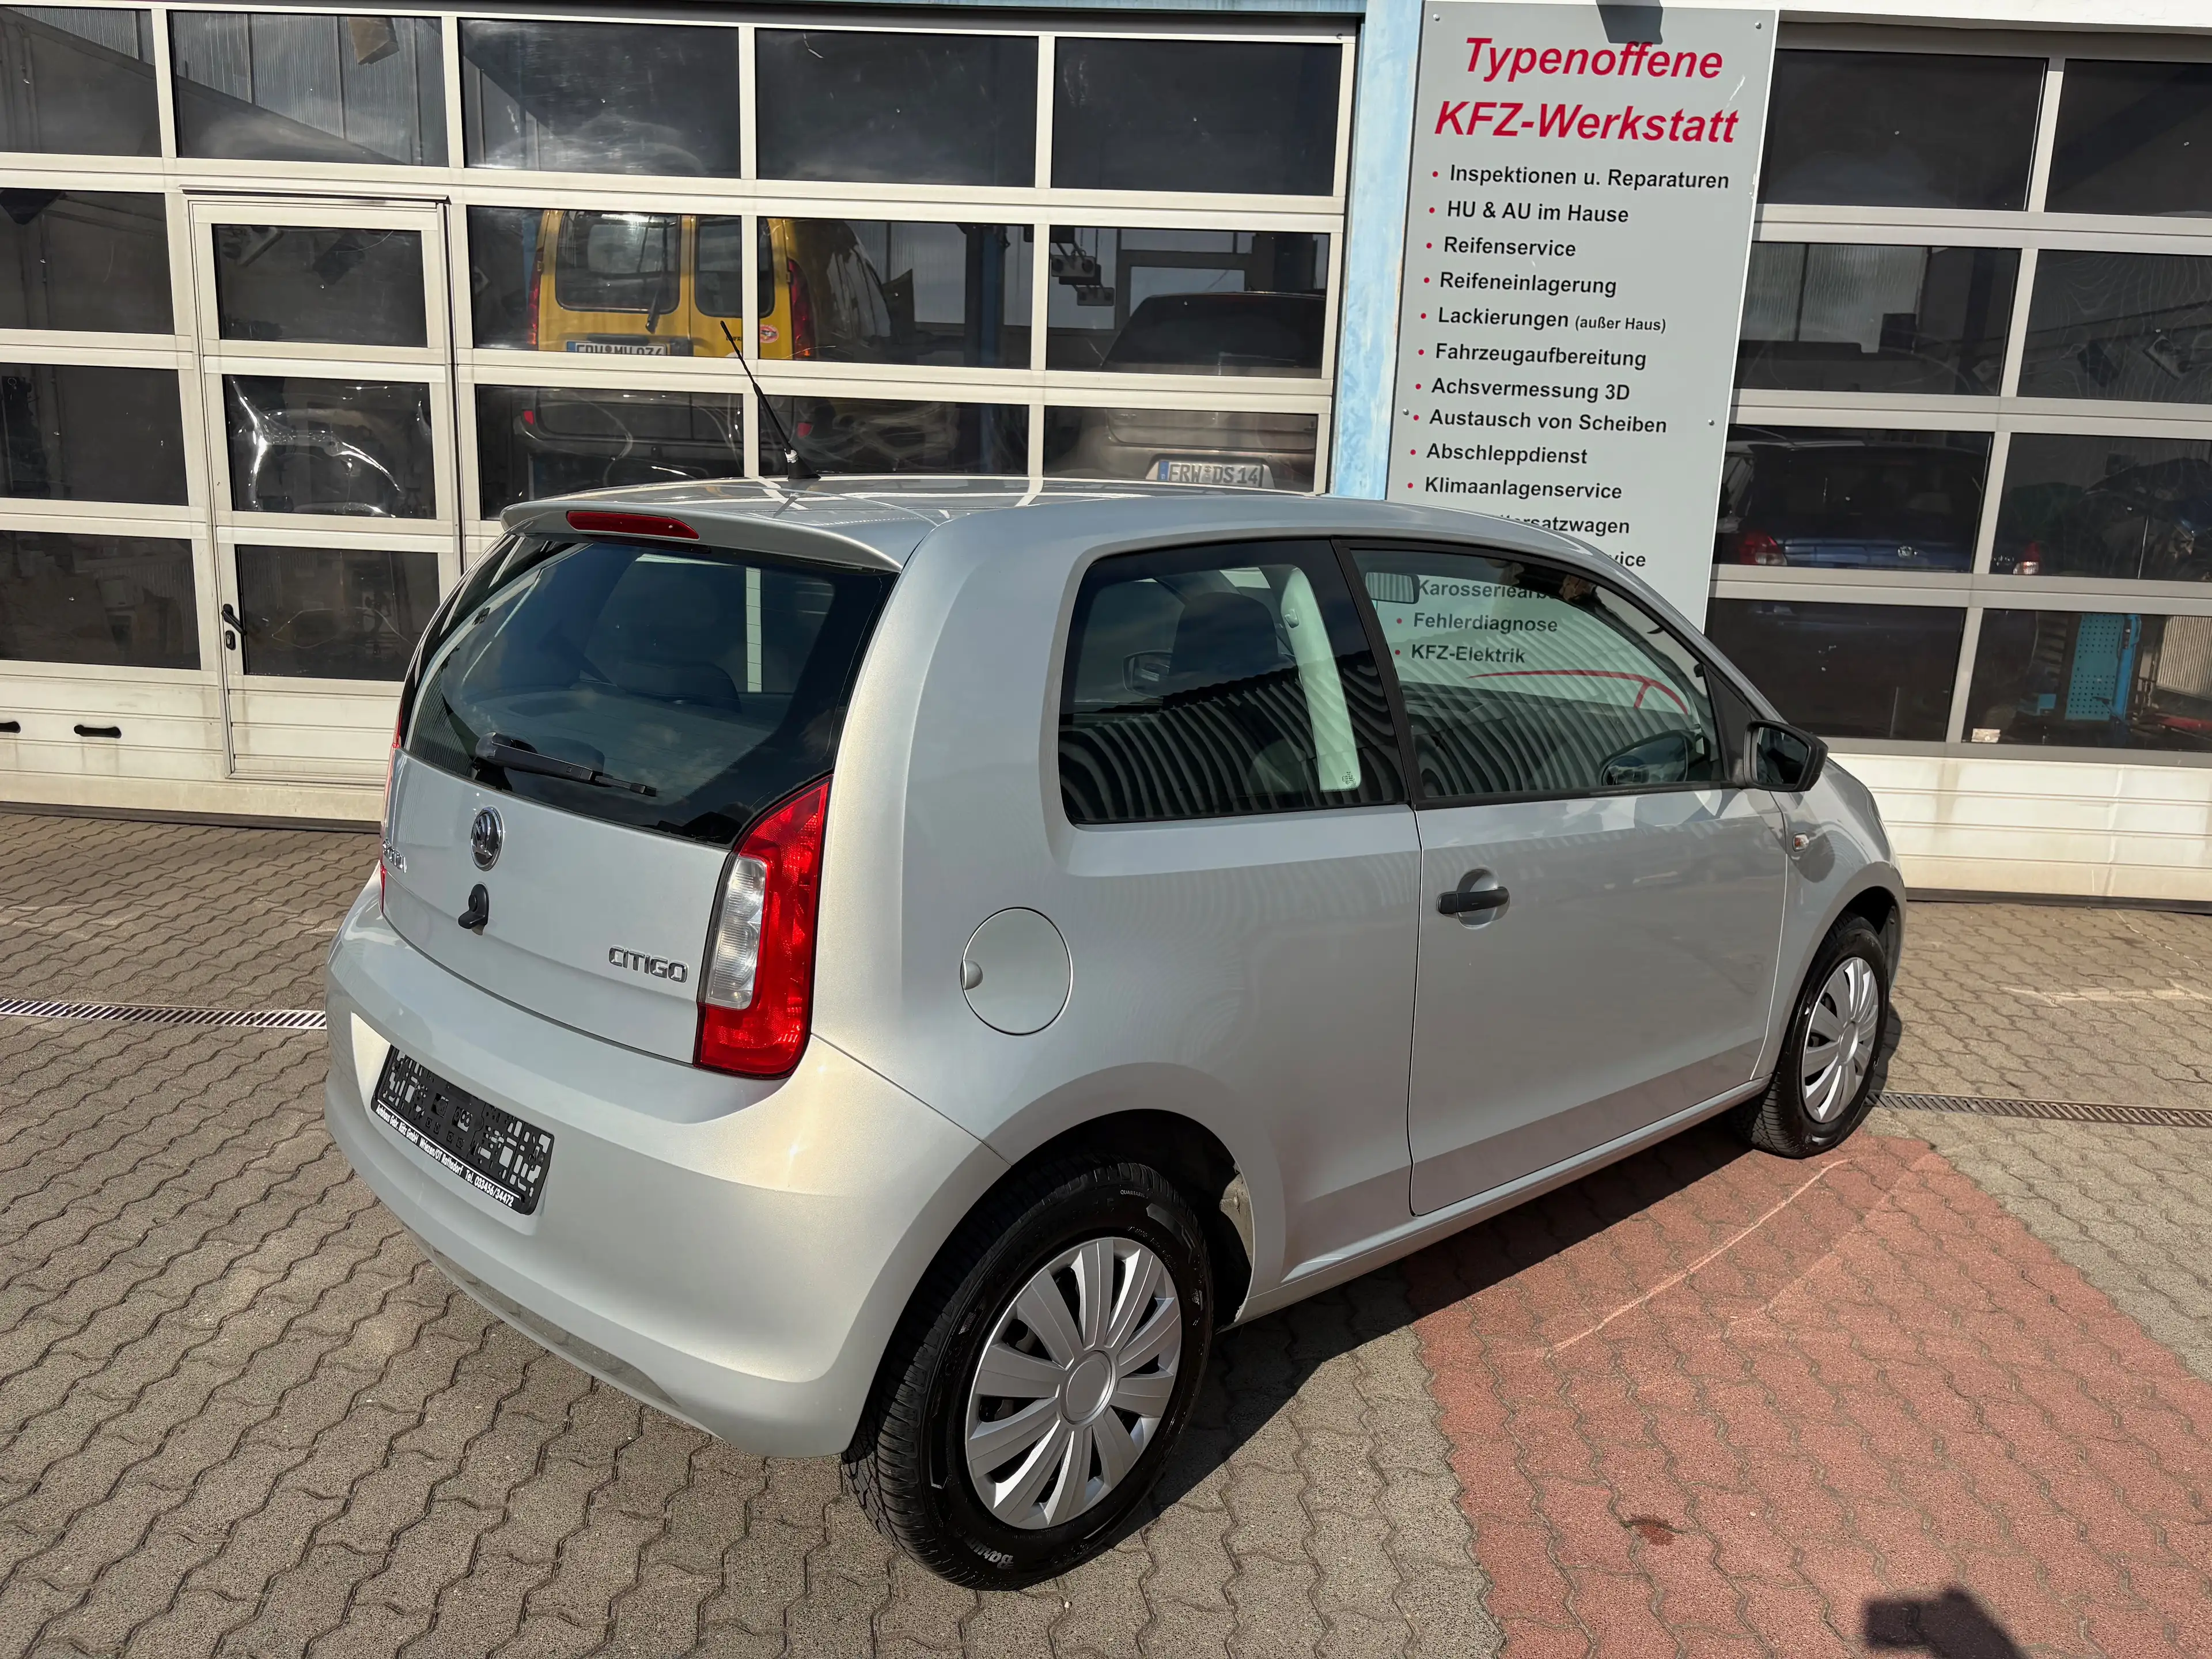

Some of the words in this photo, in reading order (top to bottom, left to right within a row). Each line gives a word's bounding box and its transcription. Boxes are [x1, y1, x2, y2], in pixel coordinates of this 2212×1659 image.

[1465, 37, 1723, 82] Typenoffene
[1434, 101, 1739, 143] KFZ-Werkstatt
[1450, 164, 1576, 186] Inspektionen
[1584, 172, 1600, 185] u.
[1608, 169, 1729, 191] Reparaturen
[1448, 200, 1476, 218] HU
[1483, 201, 1497, 218] &
[1501, 202, 1531, 219] AU
[1538, 203, 1560, 221] im
[1567, 204, 1628, 222] Hause
[1444, 236, 1576, 257] Reifenservice
[1440, 271, 1616, 298] Reifeneinlagerung
[1438, 306, 1569, 331] Lackierungen
[1575, 315, 1621, 331] (außer
[1625, 317, 1666, 334] Haus)
[1435, 343, 1646, 370] Fahrzeugaufbereitung
[1431, 377, 1599, 403] Achsvermessung
[1605, 384, 1630, 400] 3D
[1429, 408, 1531, 428] Austausch
[1537, 416, 1572, 429] von
[1579, 414, 1666, 433] Scheiben
[1426, 442, 1588, 466] Abschleppdienst
[1425, 476, 1622, 500] Klimaanlagenservice
[1414, 612, 1558, 635] Fehlerdiagnose
[1411, 643, 1525, 664] KFZ-Elektrik
[608, 945, 689, 983] CITIGO
[406, 1128, 419, 1144] GmbH
[419, 1137, 443, 1161] Wriezen/OT
[441, 1151, 464, 1176] Rathsdorf
[465, 1169, 474, 1184] Tel.
[474, 1176, 514, 1207] 033456/34472
